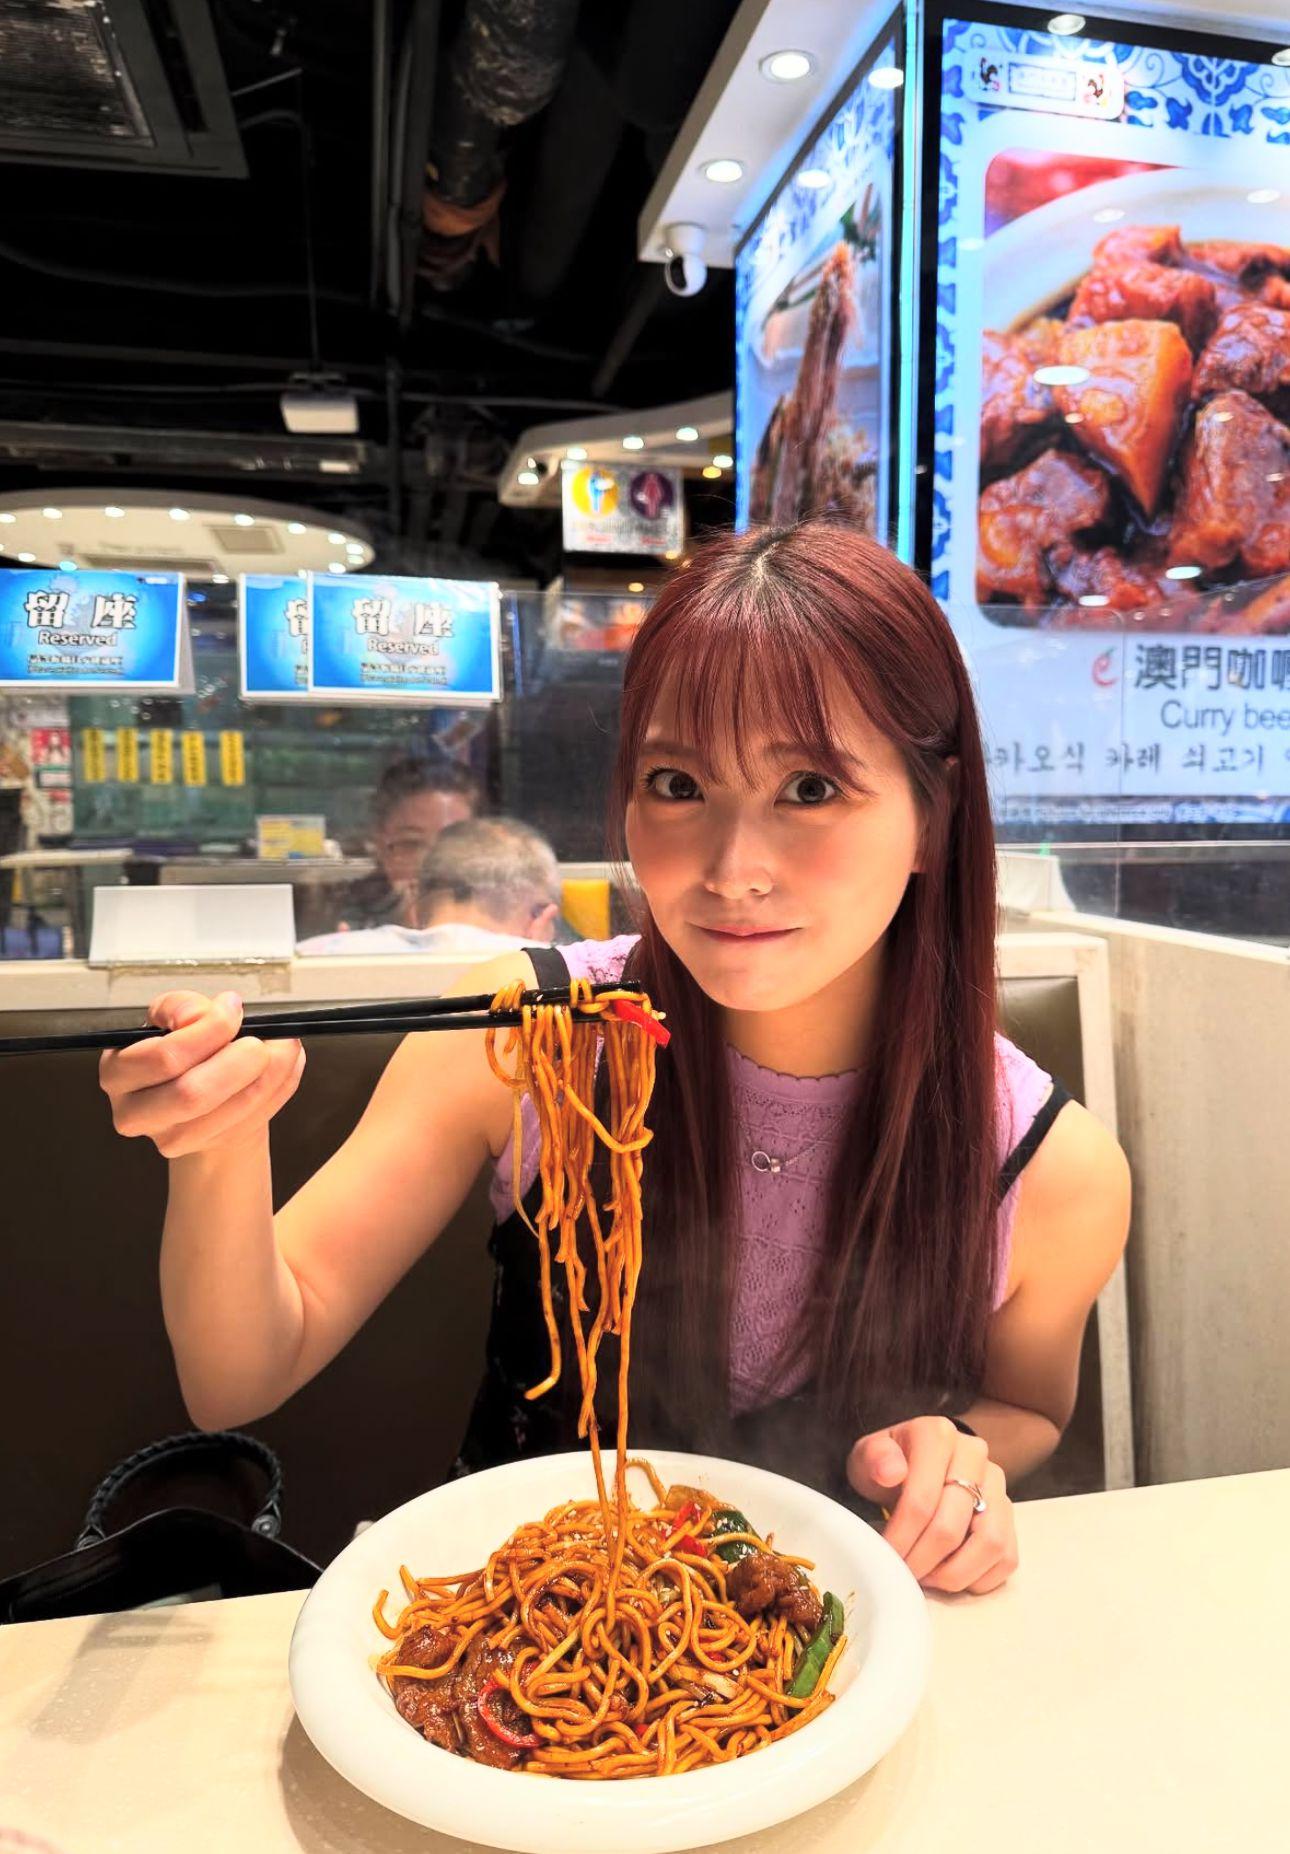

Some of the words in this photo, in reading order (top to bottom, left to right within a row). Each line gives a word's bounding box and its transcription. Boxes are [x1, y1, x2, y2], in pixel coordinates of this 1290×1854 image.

[24, 590, 139, 629] 留座
[352, 598, 455, 637] 留座
[38, 630, 118, 647] Reserved
[367, 637, 440, 656] Reserved
[1160, 699, 1235, 736] Curry
[984, 740, 1086, 775] 카오식
[1104, 742, 1161, 774] 카레
[1181, 744, 1264, 775] 쇠고기
